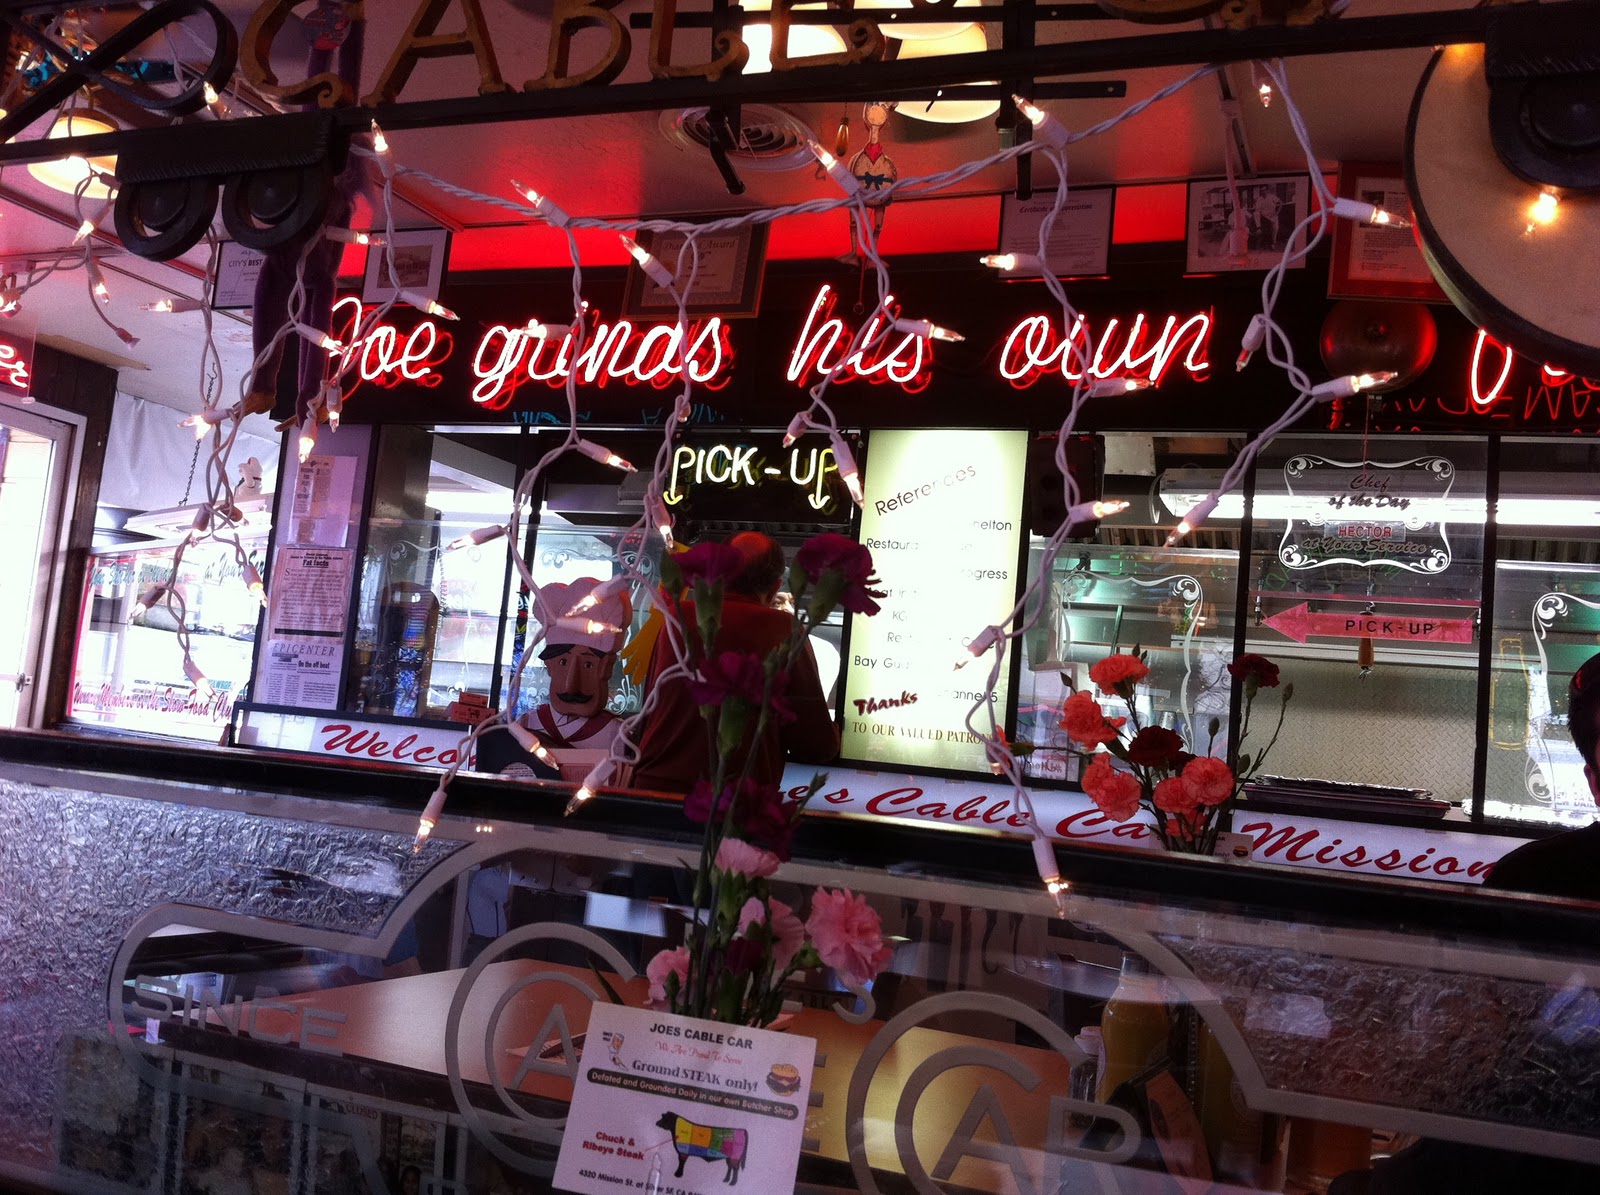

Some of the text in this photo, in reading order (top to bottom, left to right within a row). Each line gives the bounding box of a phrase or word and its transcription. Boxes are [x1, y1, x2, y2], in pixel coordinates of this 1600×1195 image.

[1061, 203, 1093, 212] ppreciation
[248, 259, 263, 267] BEST
[331, 296, 437, 381] Joe
[787, 284, 924, 383] his
[1000, 312, 1211, 382] own
[875, 465, 977, 516] References
[1349, 473, 1390, 492] Chef
[1328, 492, 1412, 510] of the Day
[1338, 525, 1393, 539] HECTOR
[1302, 536, 1428, 555] at Your Service
[302, 559, 329, 567] Fat facts
[272, 642, 336, 657] EPICENTER
[298, 660, 305, 668] On
[320, 661, 331, 669] beat
[854, 655, 878, 669] Bay
[853, 690, 919, 716] Thanks
[852, 721, 867, 734] TO
[872, 723, 896, 736] OUR
[866, 787, 1031, 827] Cable
[1241, 821, 1496, 884] Mission
[131, 974, 348, 1057] SINCE
[650, 1023, 753, 1049] JOES CABLE CAR
[632, 1059, 759, 1093] Ground STEAK only!
[623, 1076, 638, 1087] and
[640, 1081, 677, 1095] Grounded
[678, 1087, 698, 1099] Daily
[699, 1092, 707, 1100] in
[708, 1095, 722, 1103] our
[724, 1097, 740, 1106] own
[742, 1099, 772, 1112] Butcher
[773, 1105, 794, 1118] Shop
[595, 1131, 635, 1147] Chuck &
[582, 1140, 645, 1161] Ribeye Steak
[578, 1169, 597, 1180] 4320
[597, 1172, 624, 1186] Mission
